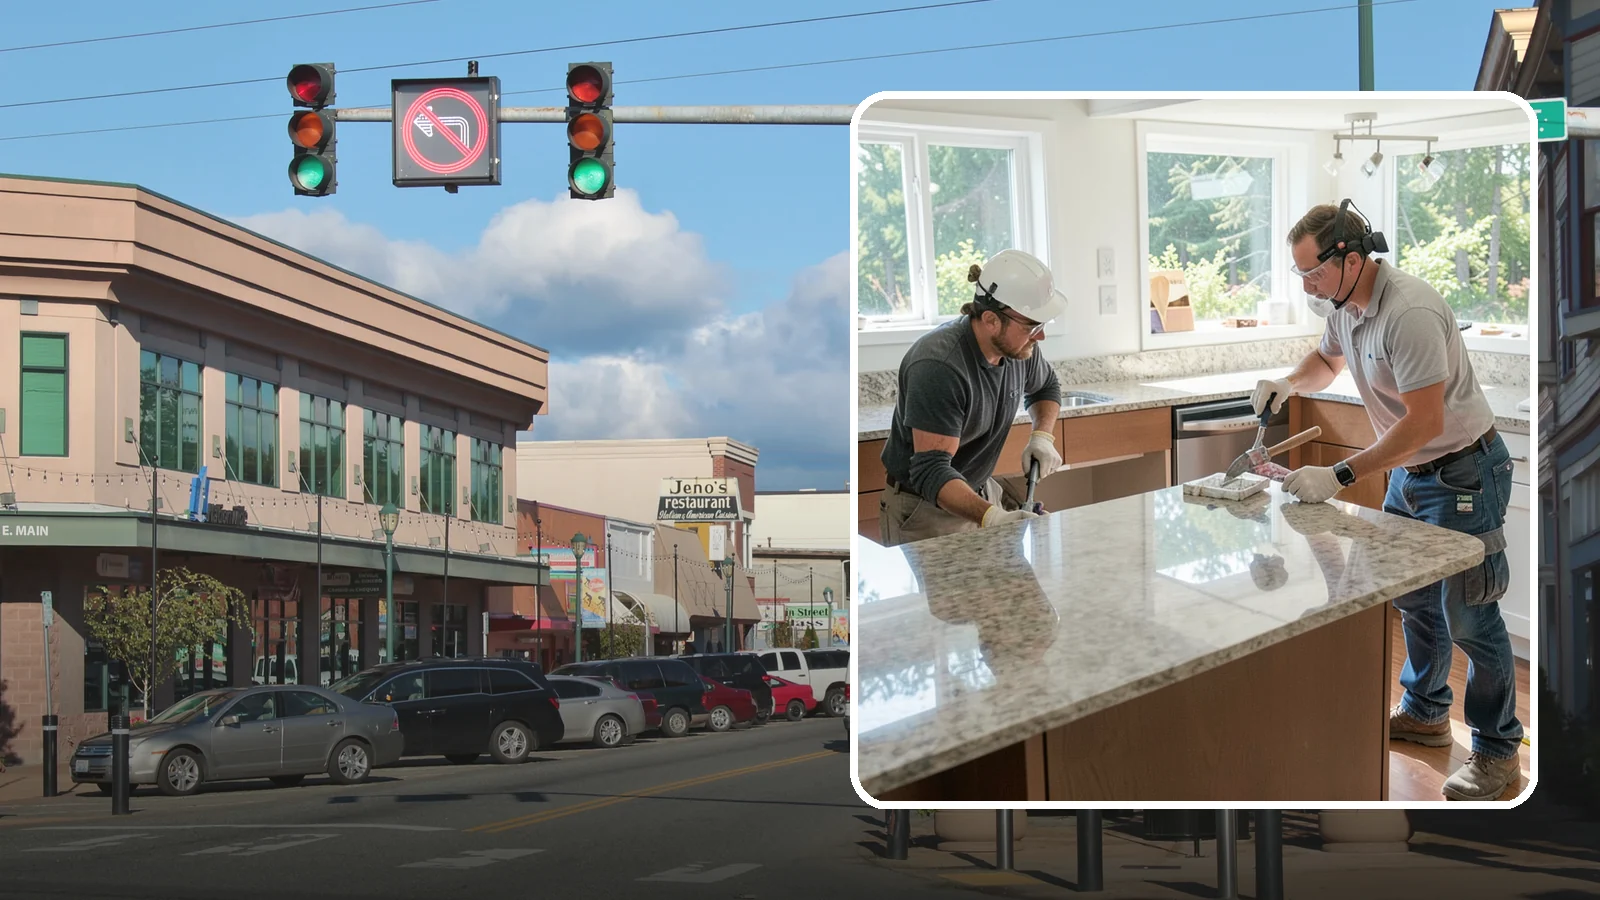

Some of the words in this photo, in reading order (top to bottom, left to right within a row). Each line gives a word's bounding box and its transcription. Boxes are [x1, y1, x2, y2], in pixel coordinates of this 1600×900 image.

[669, 480, 728, 495] Jeno's
[664, 496, 731, 509] restaurant
[658, 509, 682, 520] Italian
[685, 509, 714, 519] American
[713, 509, 738, 519] Cuisine
[2, 525, 13, 536] E.
[15, 525, 49, 537] MAIN
[797, 607, 828, 617] Street
